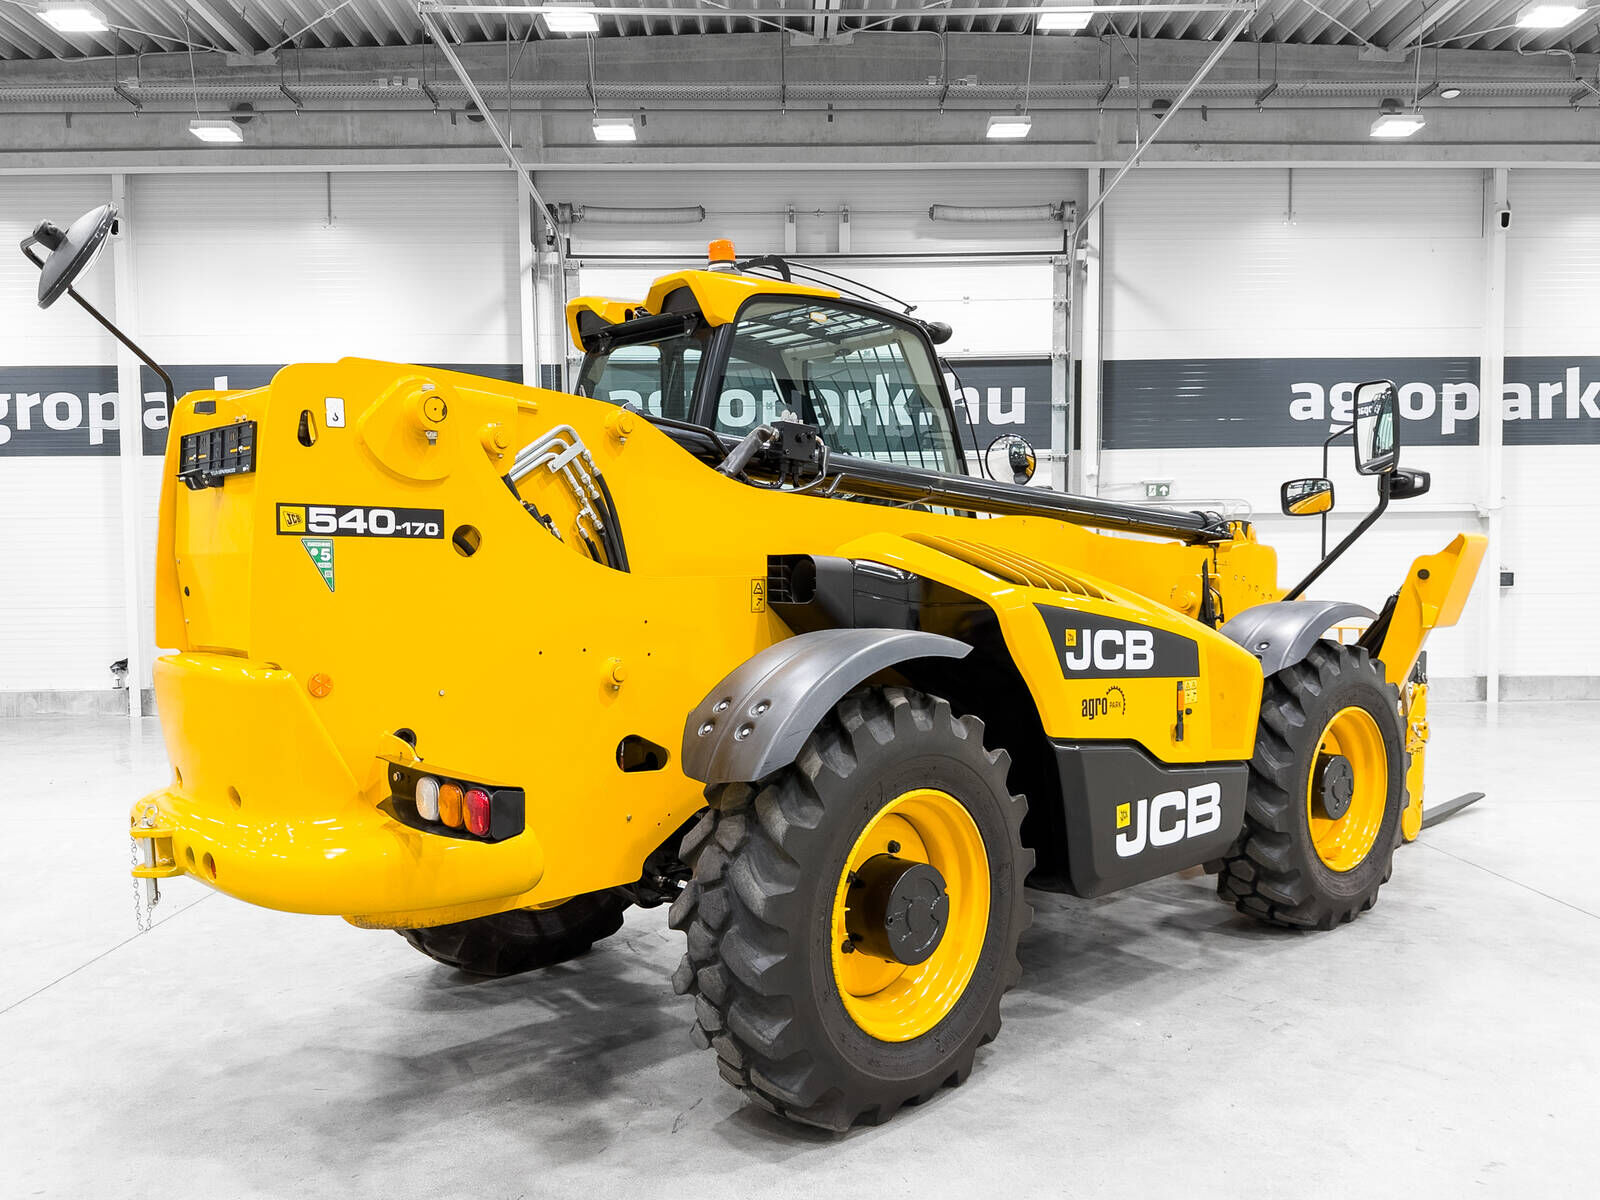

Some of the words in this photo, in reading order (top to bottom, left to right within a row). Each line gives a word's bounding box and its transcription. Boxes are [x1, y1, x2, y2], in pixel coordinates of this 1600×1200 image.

[308, 506, 439, 536] 540-170
[320, 547, 331, 562] 5
[1065, 628, 1155, 671] JCB
[1081, 697, 1107, 720] agro
[1115, 781, 1222, 858] JCB
